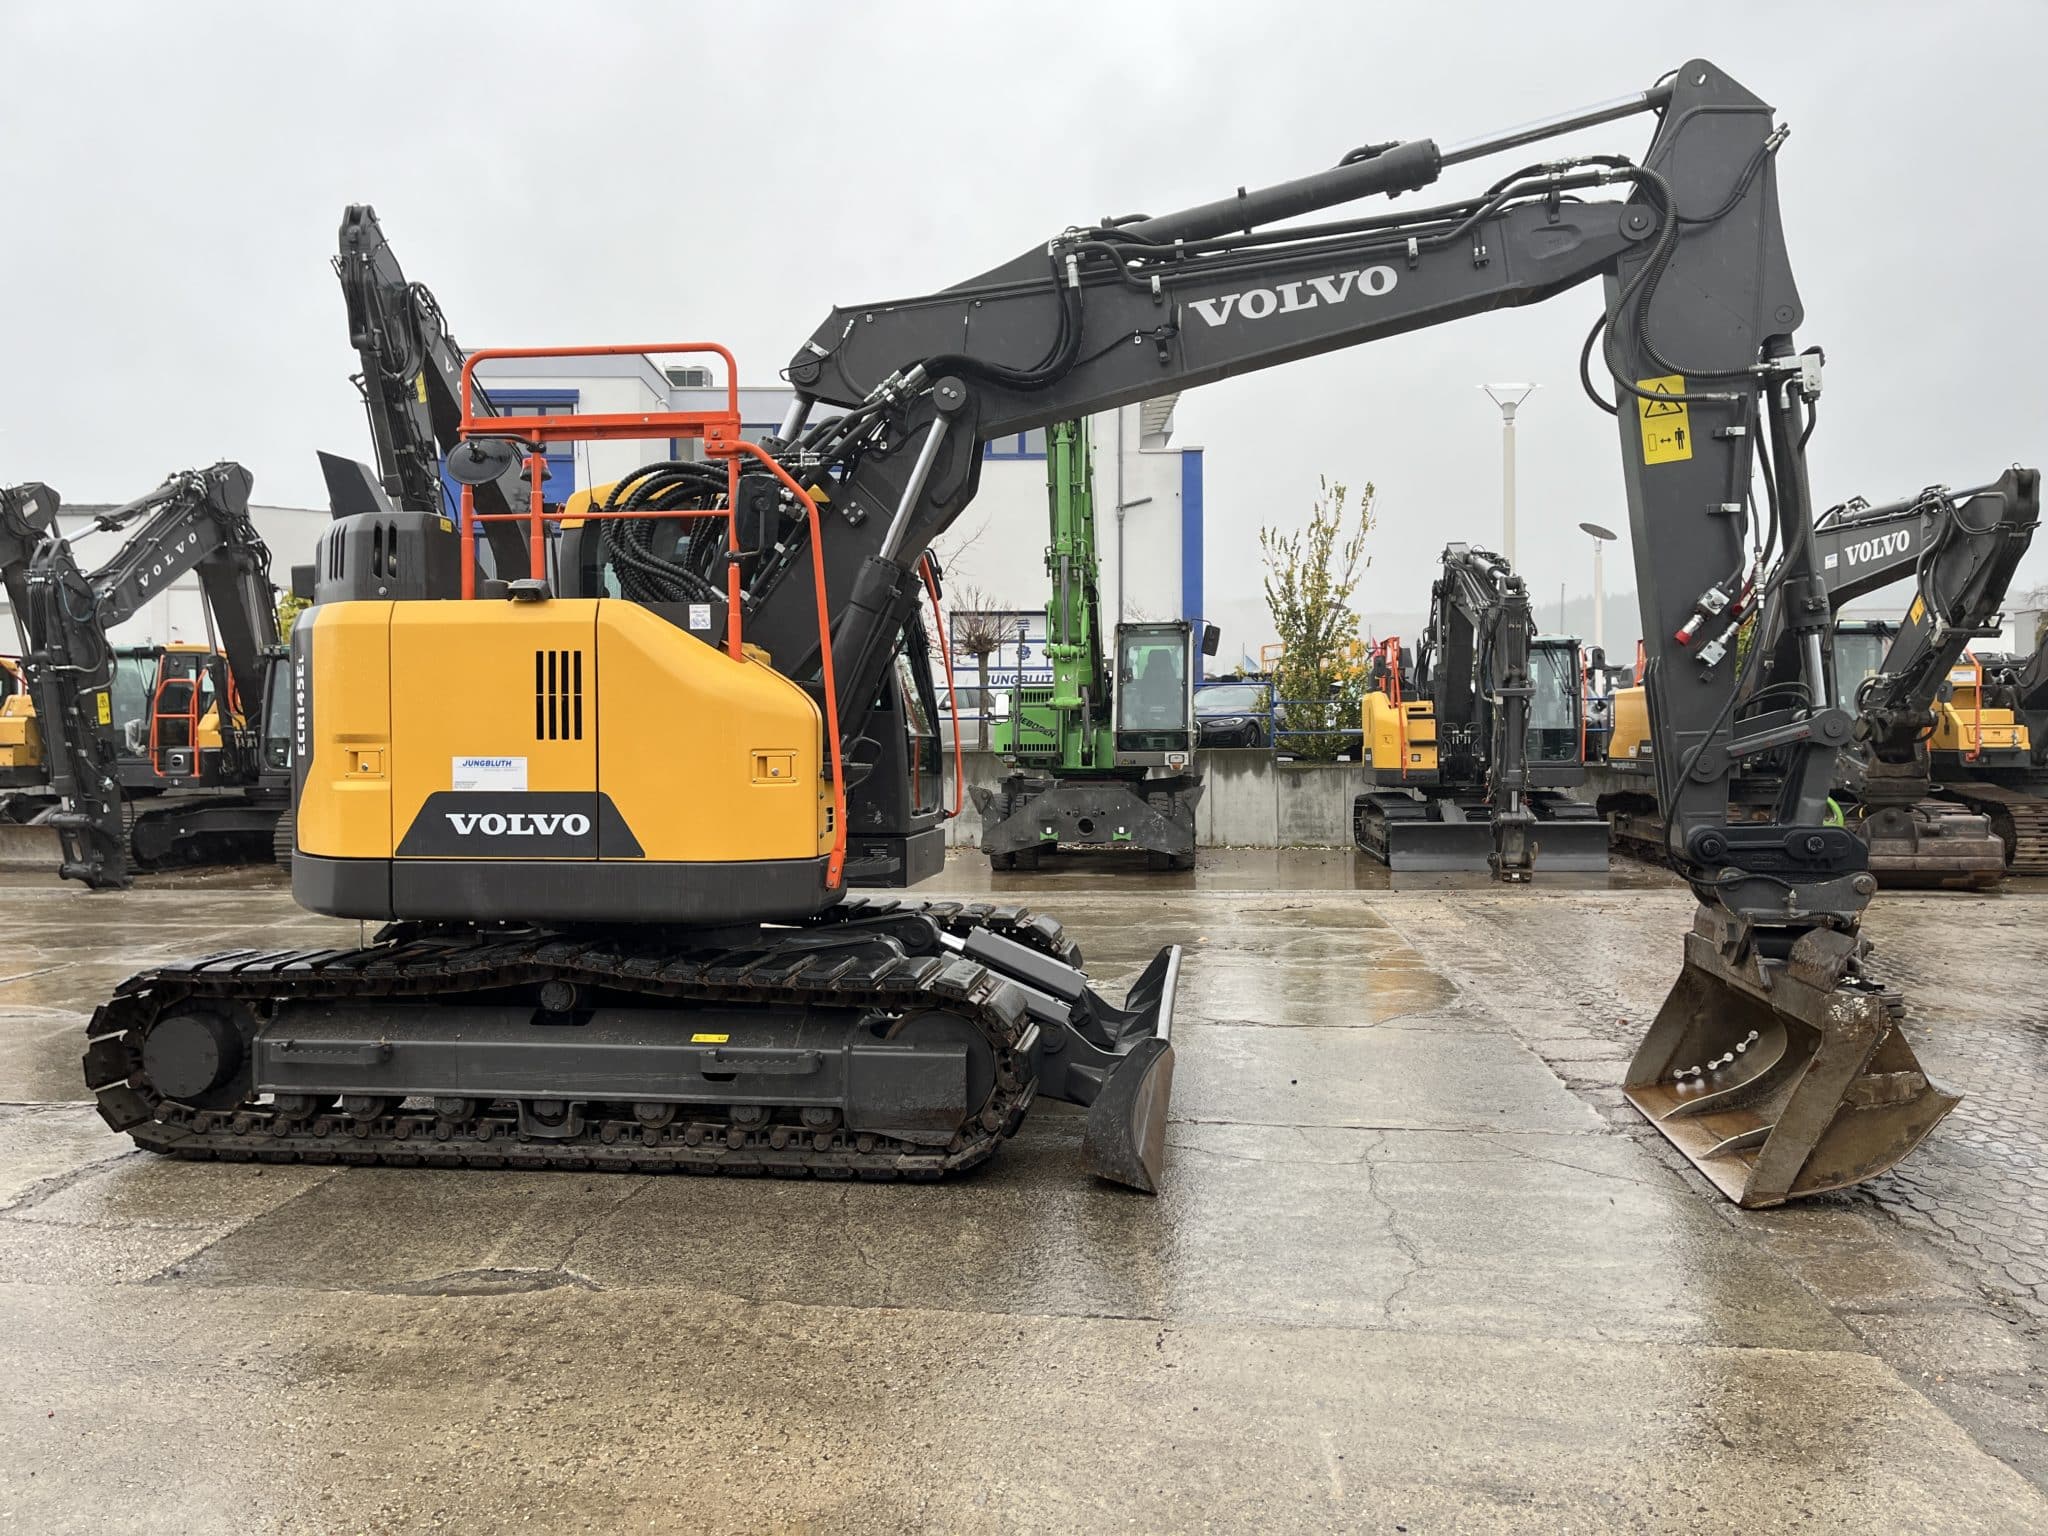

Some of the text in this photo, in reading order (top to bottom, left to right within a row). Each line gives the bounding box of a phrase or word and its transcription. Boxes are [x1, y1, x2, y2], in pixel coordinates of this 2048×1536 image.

[1188, 265, 1399, 327] VOLVO
[139, 532, 197, 587] VOLVO
[1844, 529, 1910, 566] VOLVO
[296, 654, 306, 756] ECR145EL
[462, 759, 512, 767] JUNGBLUTH
[445, 813, 591, 836] VOLVO
